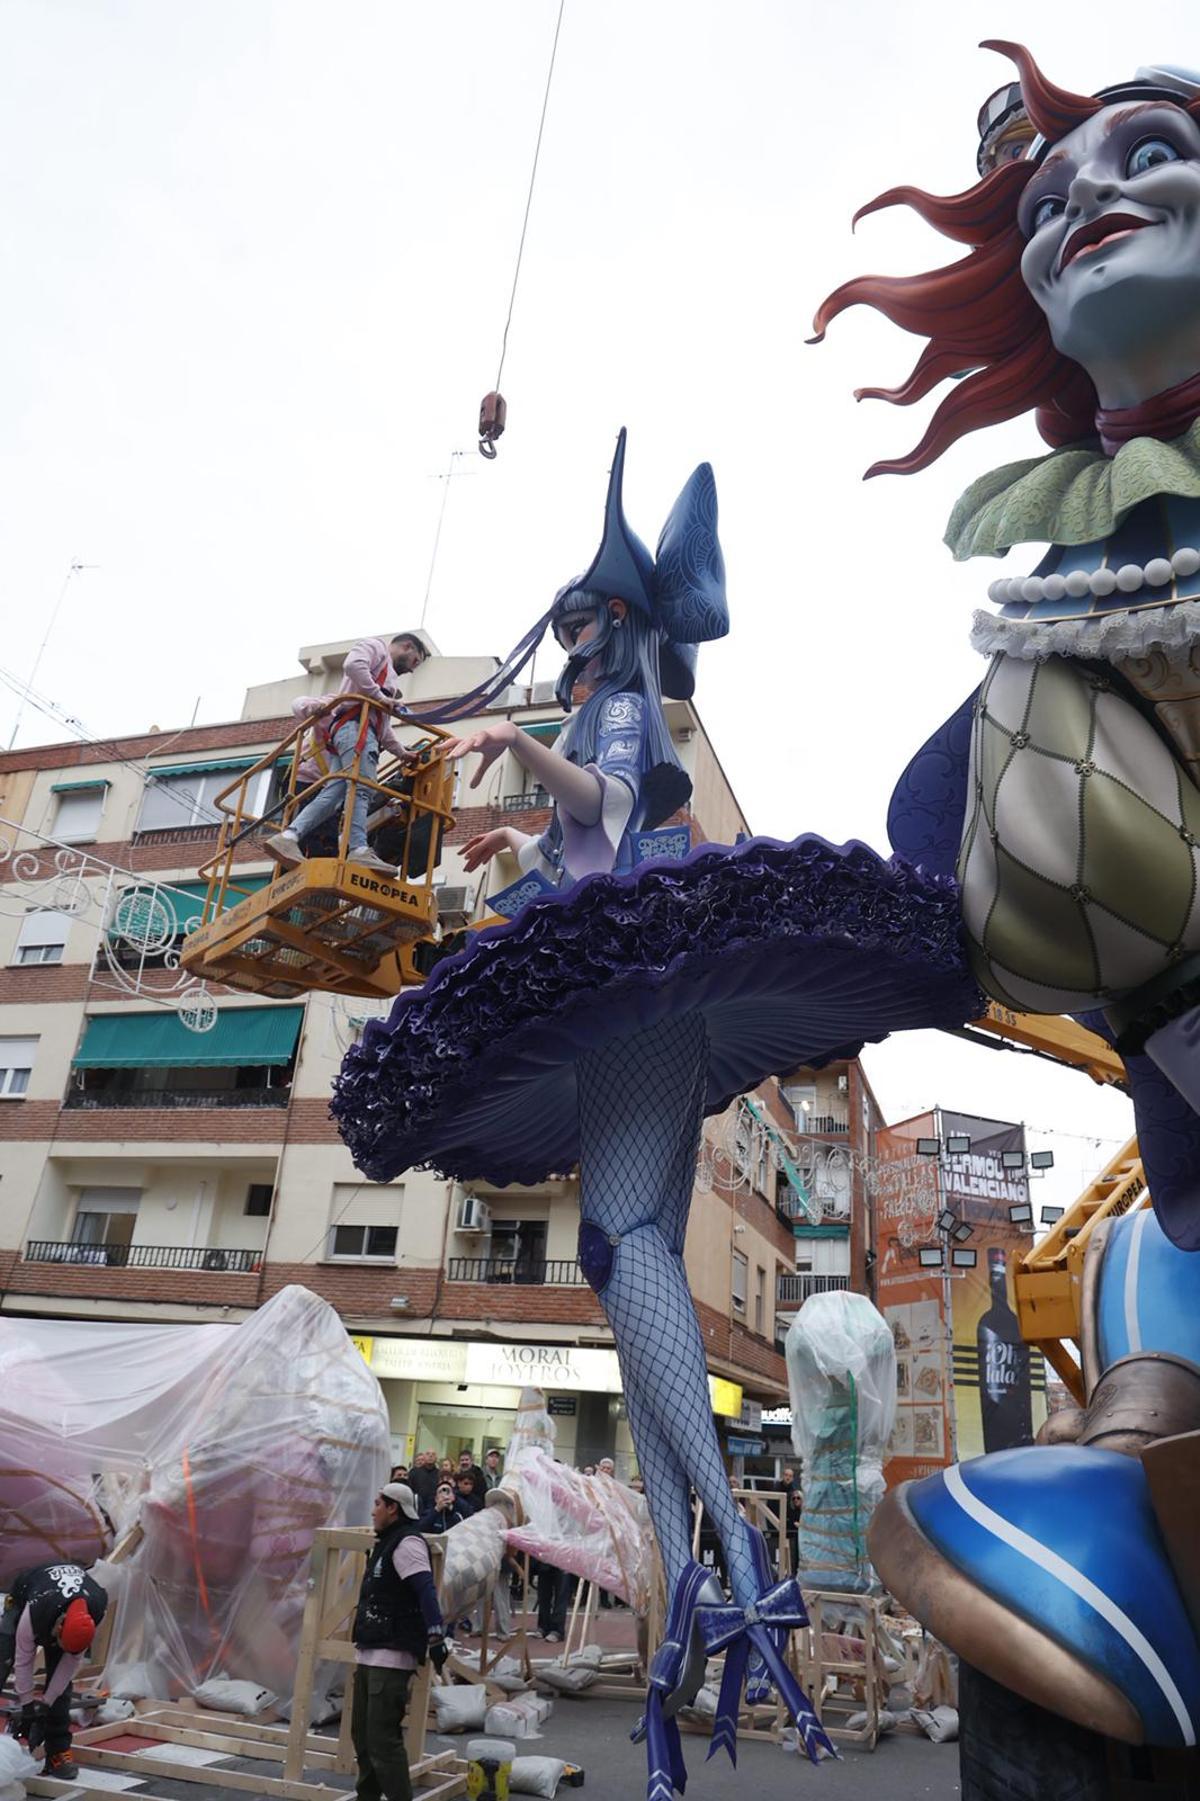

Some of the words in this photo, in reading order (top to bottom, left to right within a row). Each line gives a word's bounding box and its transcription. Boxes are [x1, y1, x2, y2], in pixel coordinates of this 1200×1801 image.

[351, 873, 419, 907] EUROPEA
[943, 1171, 1029, 1203] VALENCIANO
[488, 1362, 582, 1382] JOYEROS
